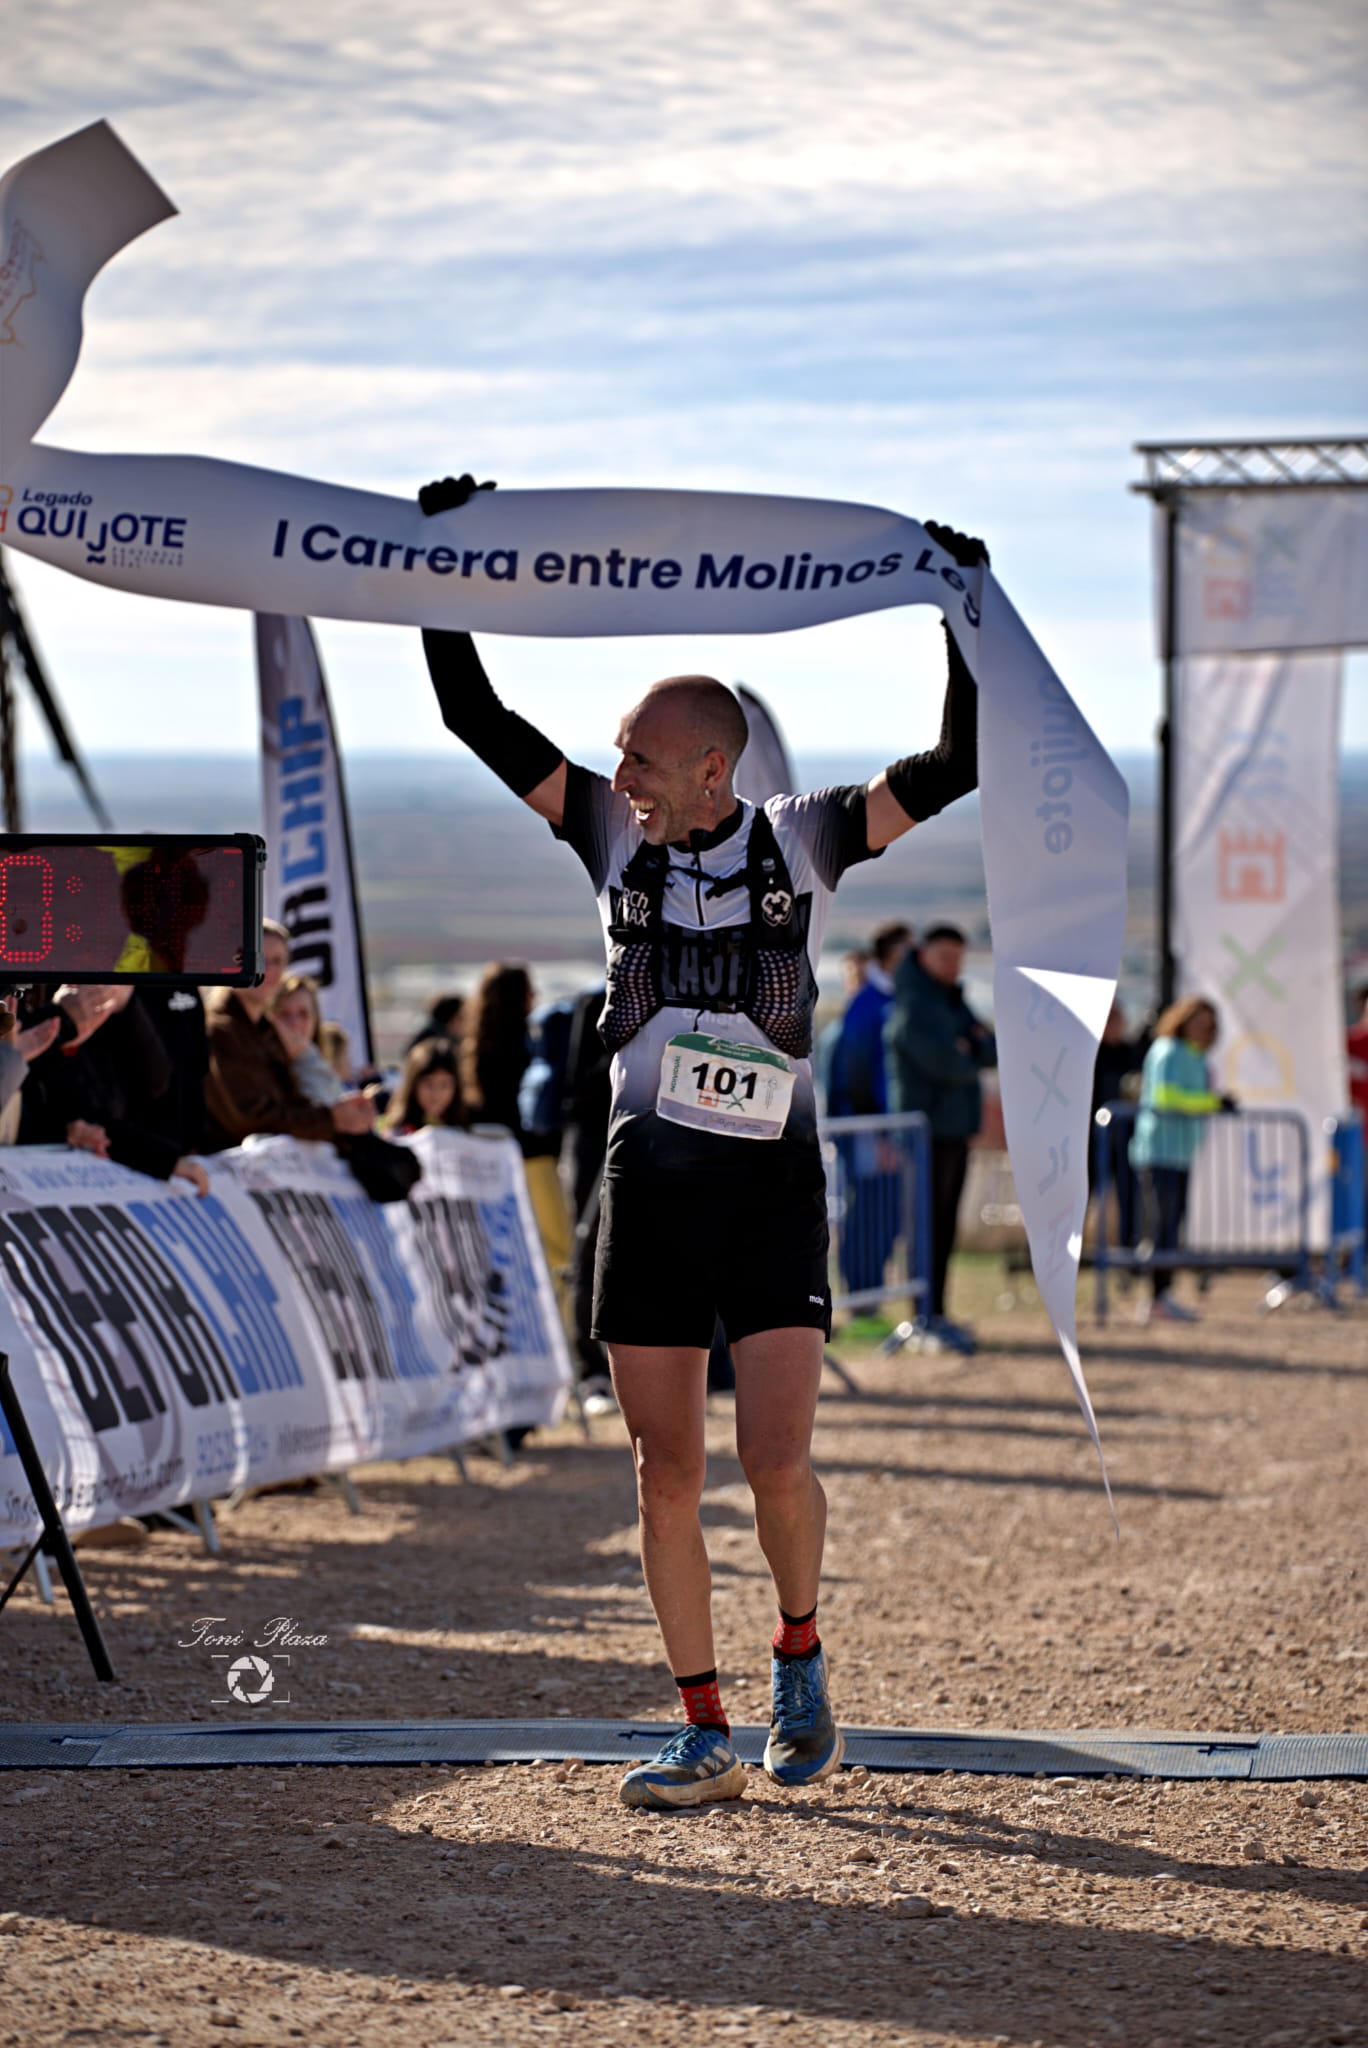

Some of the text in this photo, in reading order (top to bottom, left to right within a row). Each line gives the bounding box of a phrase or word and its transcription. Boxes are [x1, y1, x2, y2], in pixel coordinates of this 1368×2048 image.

[22, 487, 93, 507] Legado
[272, 519, 289, 558] I
[301, 523, 518, 582] Carrera
[533, 548, 683, 590] entre
[695, 550, 904, 591] Molinos
[691, 1062, 758, 1100] 101
